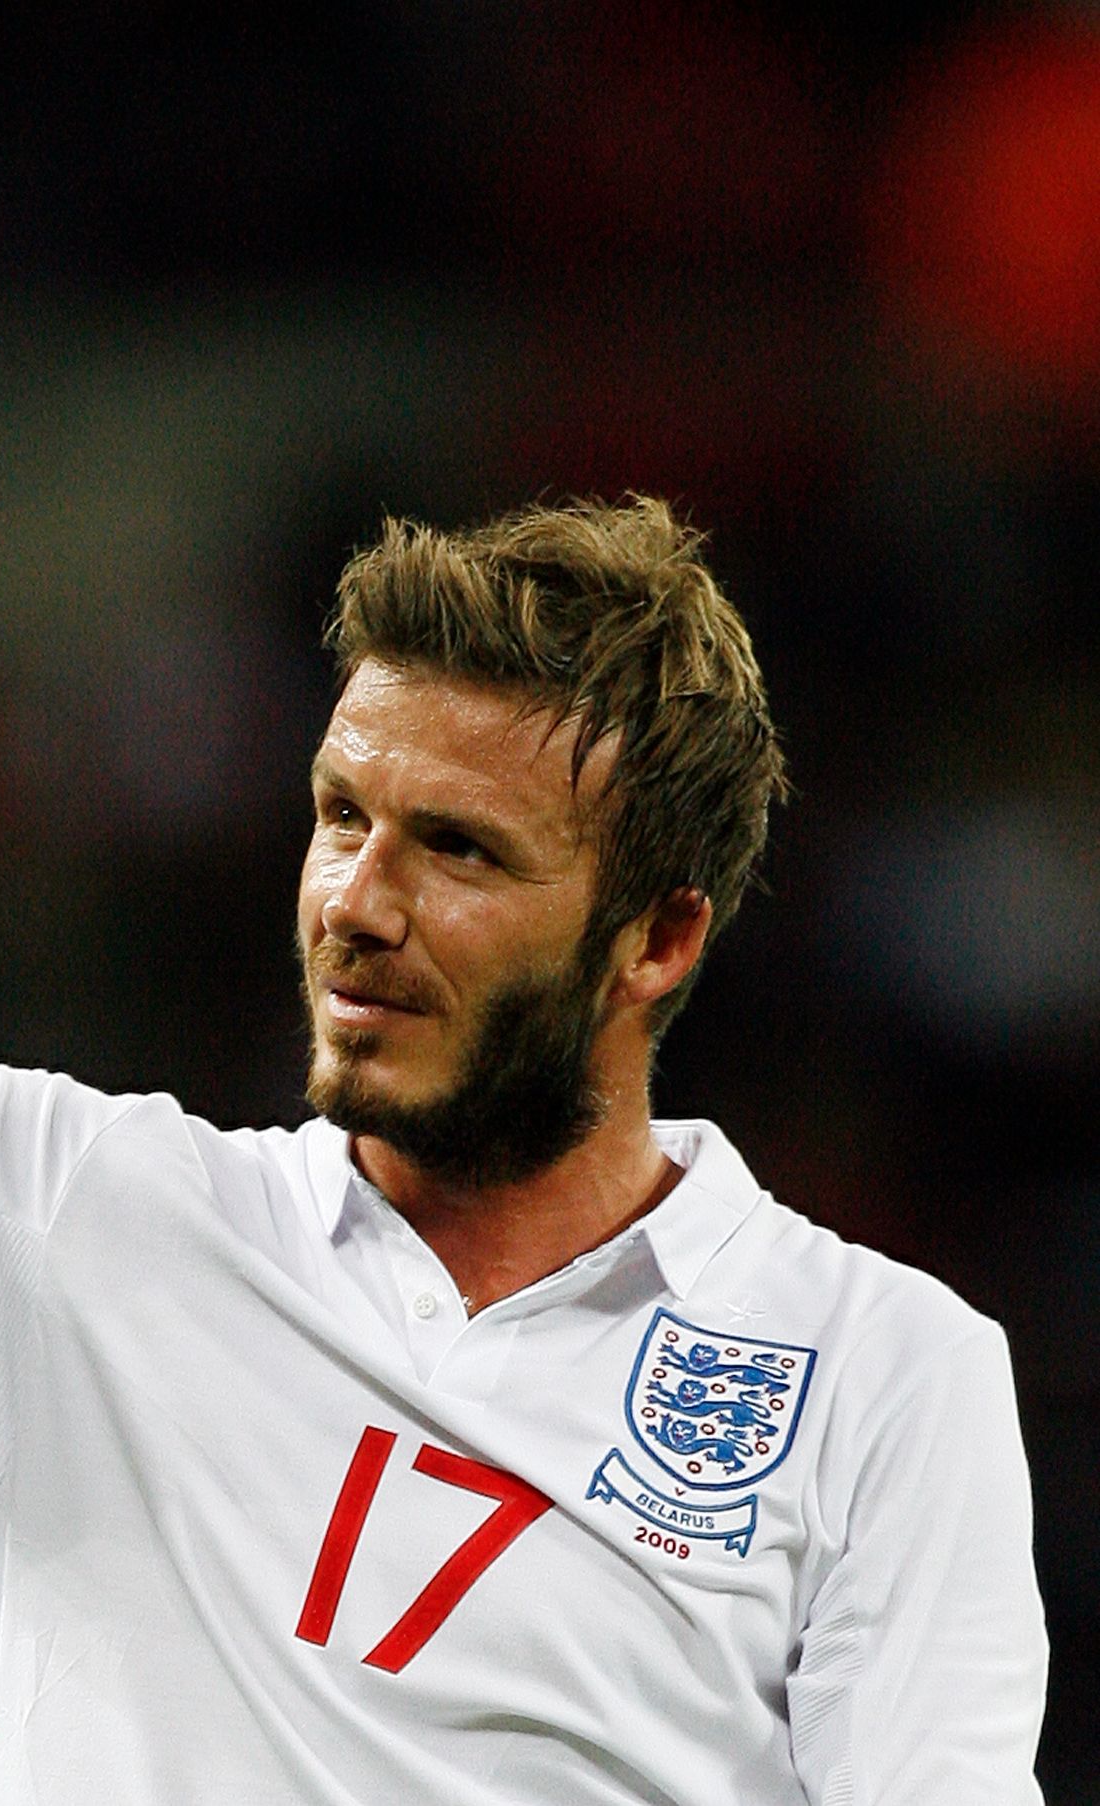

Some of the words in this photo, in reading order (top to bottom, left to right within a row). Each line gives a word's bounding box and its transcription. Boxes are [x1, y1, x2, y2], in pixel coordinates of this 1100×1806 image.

[636, 1493, 715, 1529] BELARUS
[295, 1425, 555, 1674] 17
[634, 1526, 690, 1559] 2009
